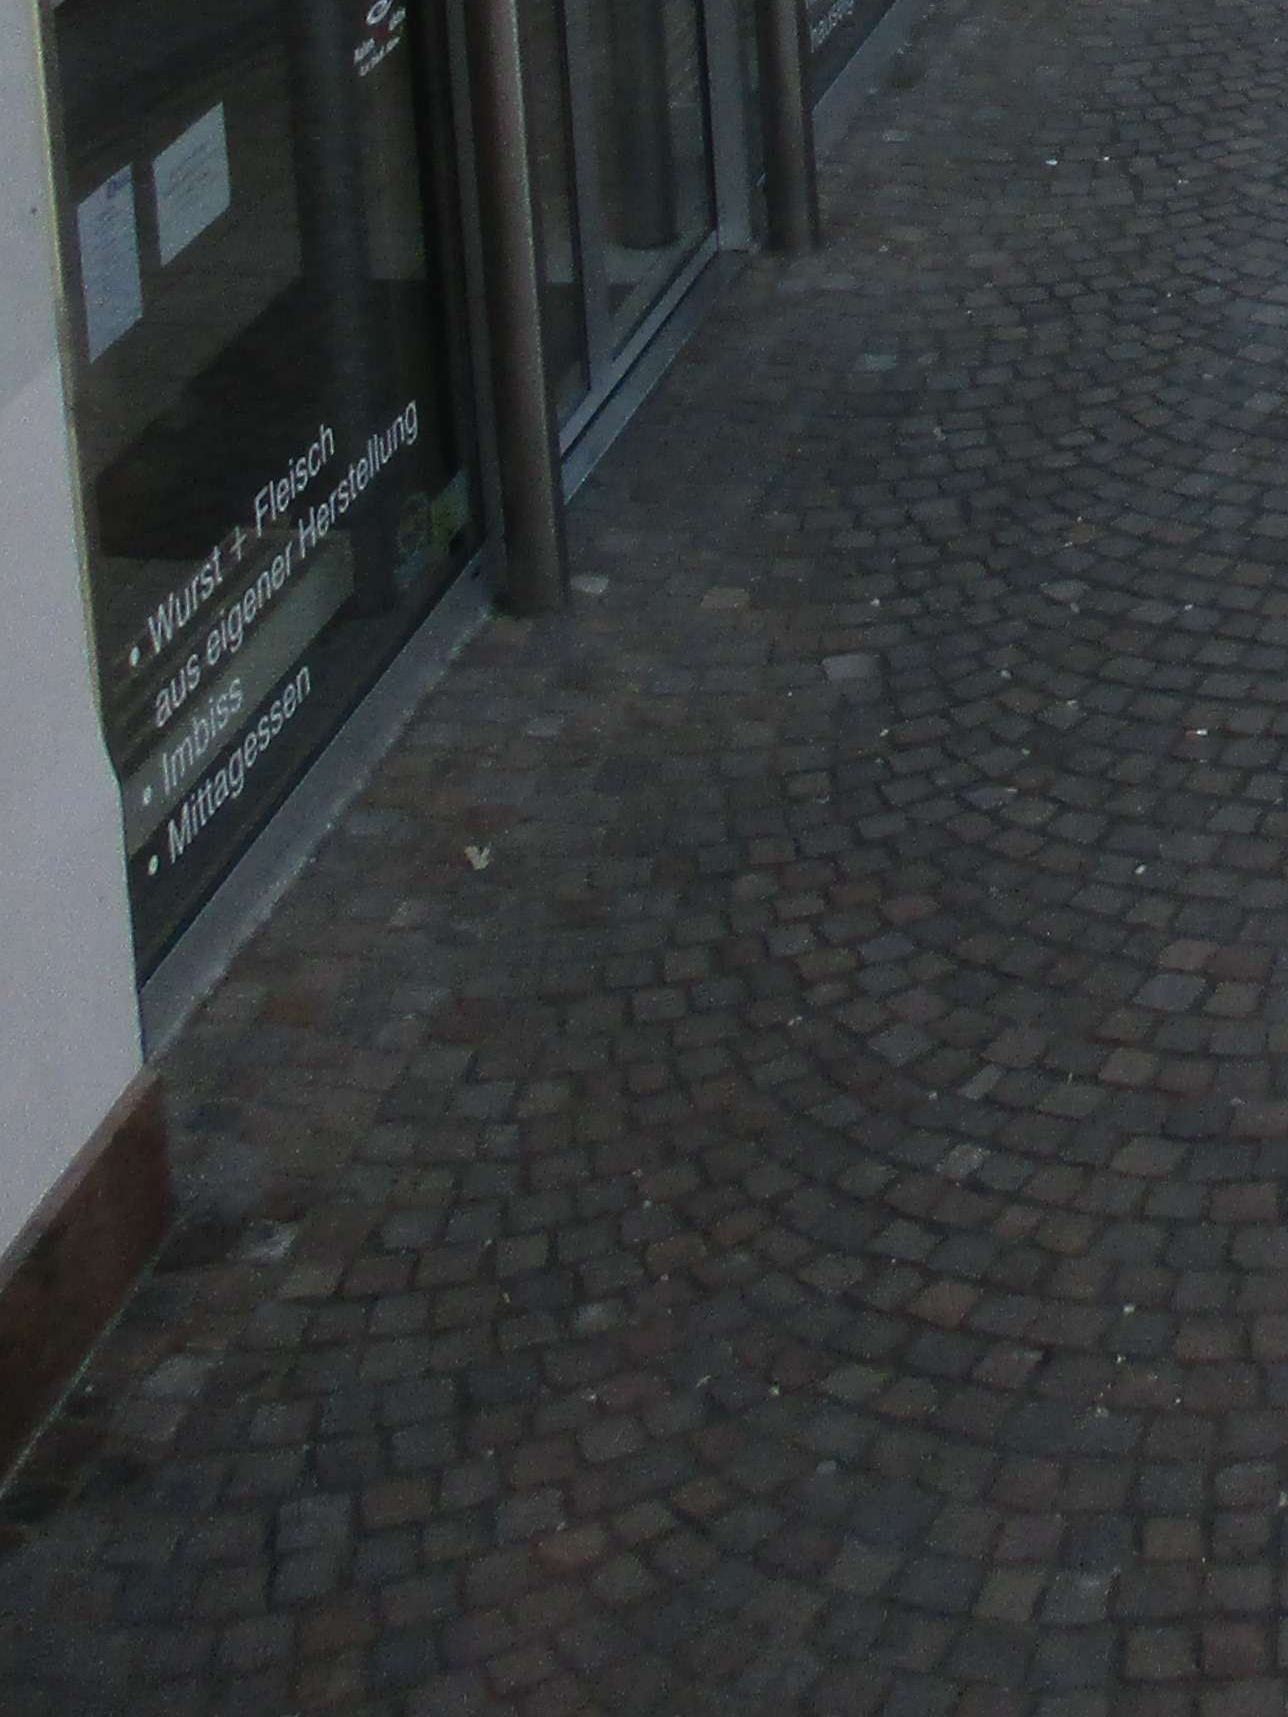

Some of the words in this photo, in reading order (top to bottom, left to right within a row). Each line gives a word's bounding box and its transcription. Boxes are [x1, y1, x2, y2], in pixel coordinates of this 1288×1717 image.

[148, 546, 223, 654] Wurst
[229, 525, 247, 561] +
[253, 423, 335, 538] Fleisch
[155, 653, 201, 727] aus
[206, 541, 292, 666] eigener
[298, 399, 418, 559] Herstellung
[161, 678, 243, 796] Imbiss
[167, 666, 311, 864] Mittagessen
